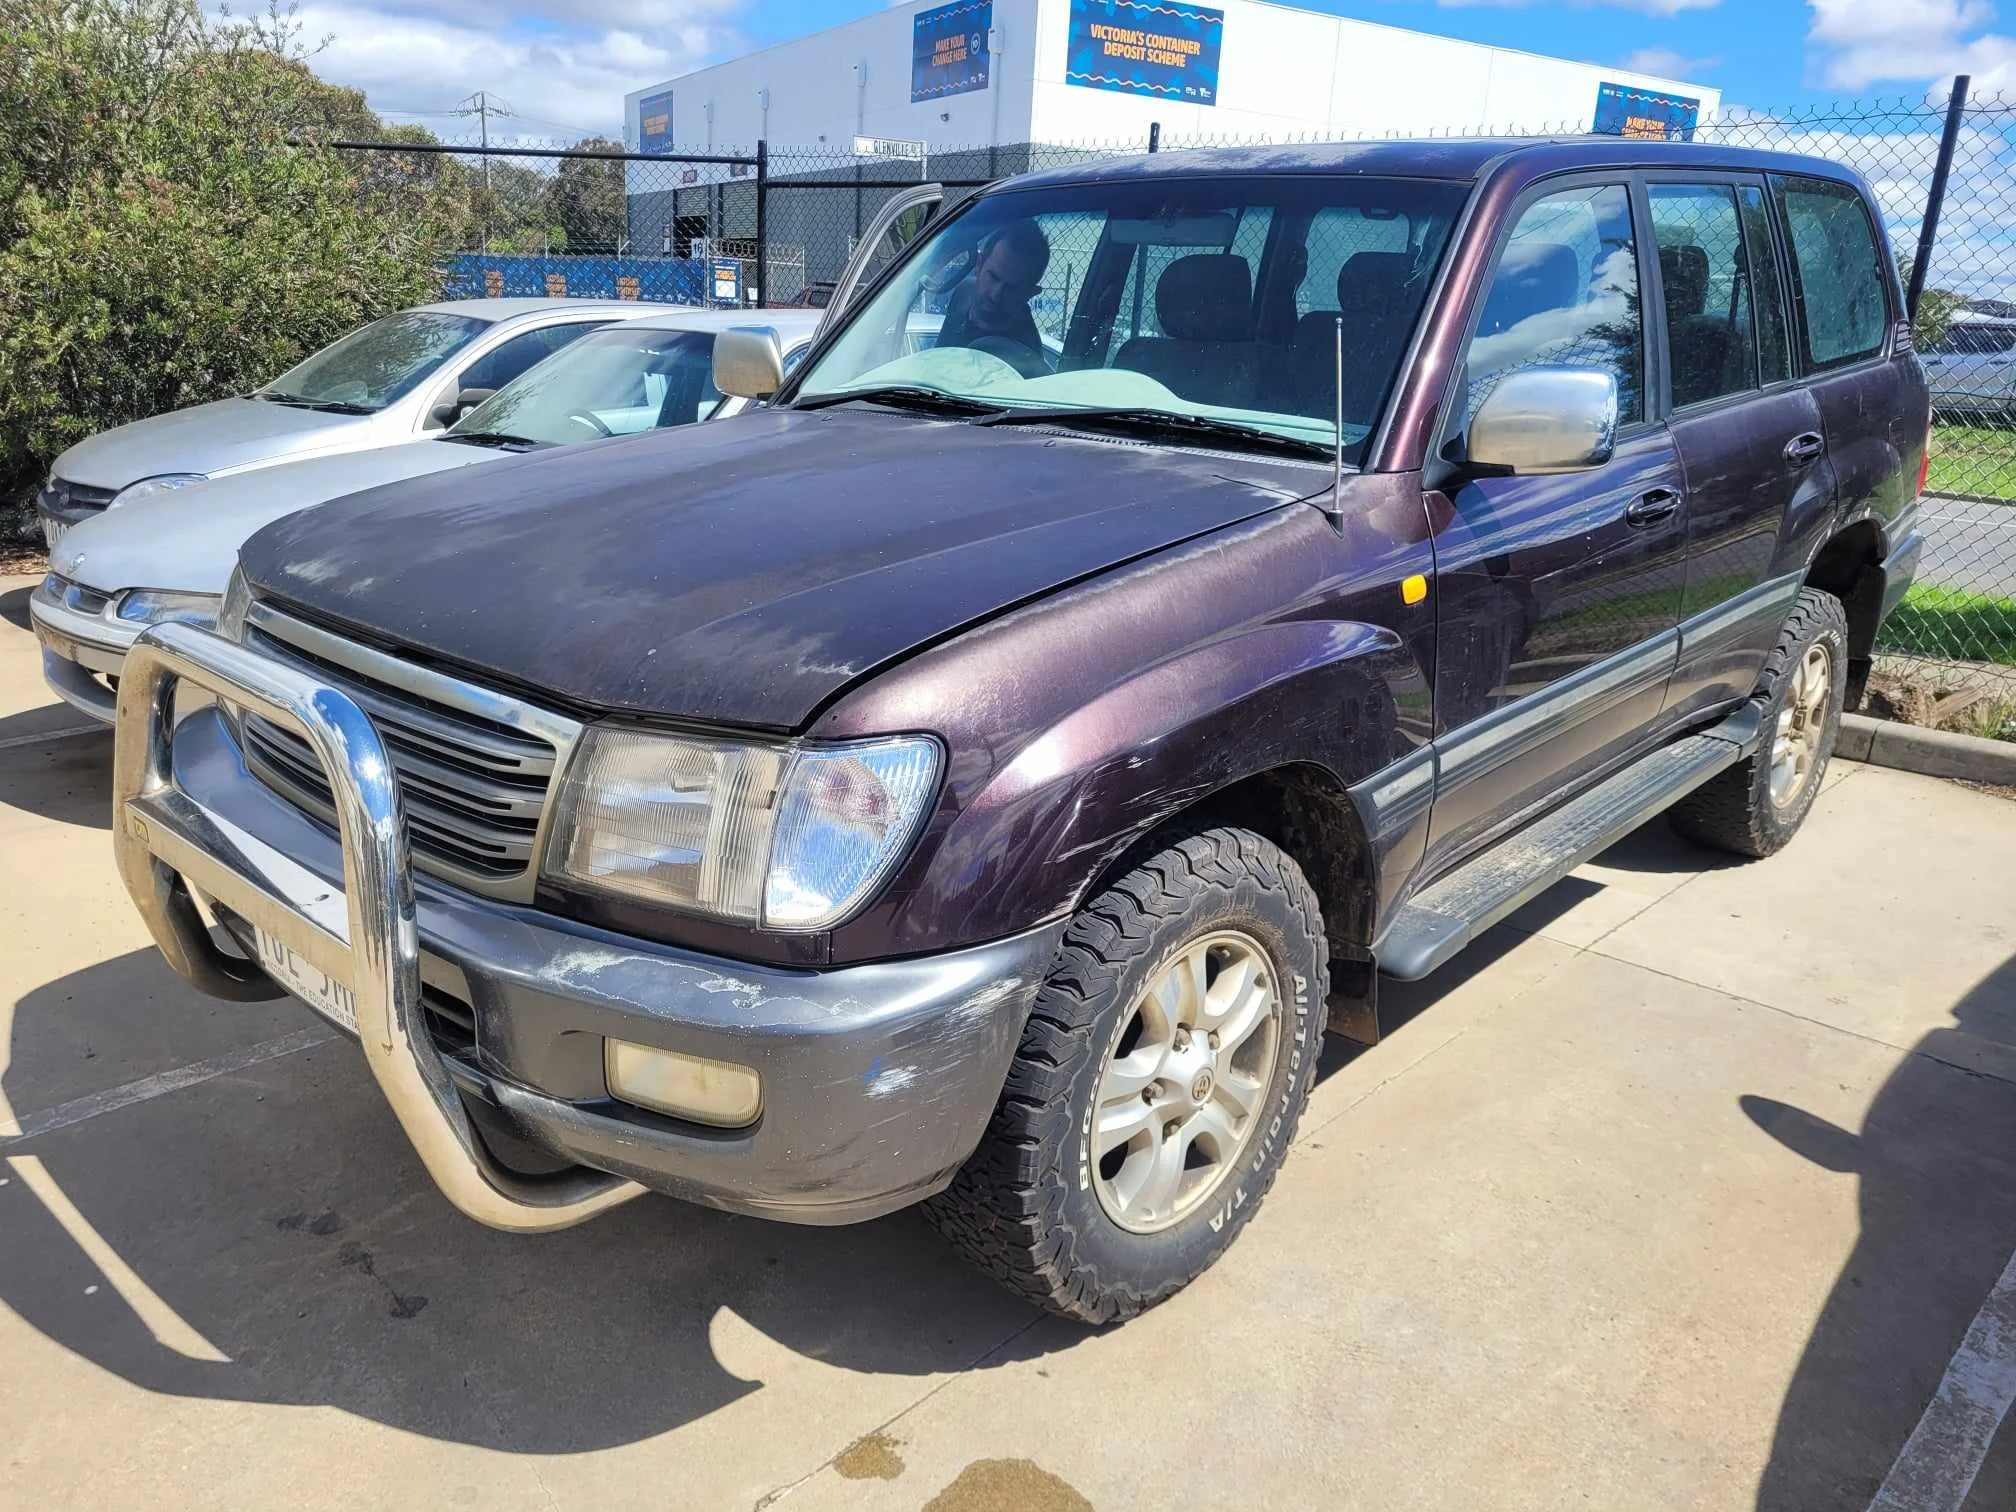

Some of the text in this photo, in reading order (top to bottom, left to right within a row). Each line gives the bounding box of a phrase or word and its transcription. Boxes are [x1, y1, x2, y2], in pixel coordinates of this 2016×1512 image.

[936, 37, 949, 53] MAKE
[1090, 23, 1201, 55] VICTORIA'S CONTAINER
[1103, 41, 1186, 67] DEPOSIT SCHEME
[1208, 974, 1308, 1233] All-Terrain T/A
